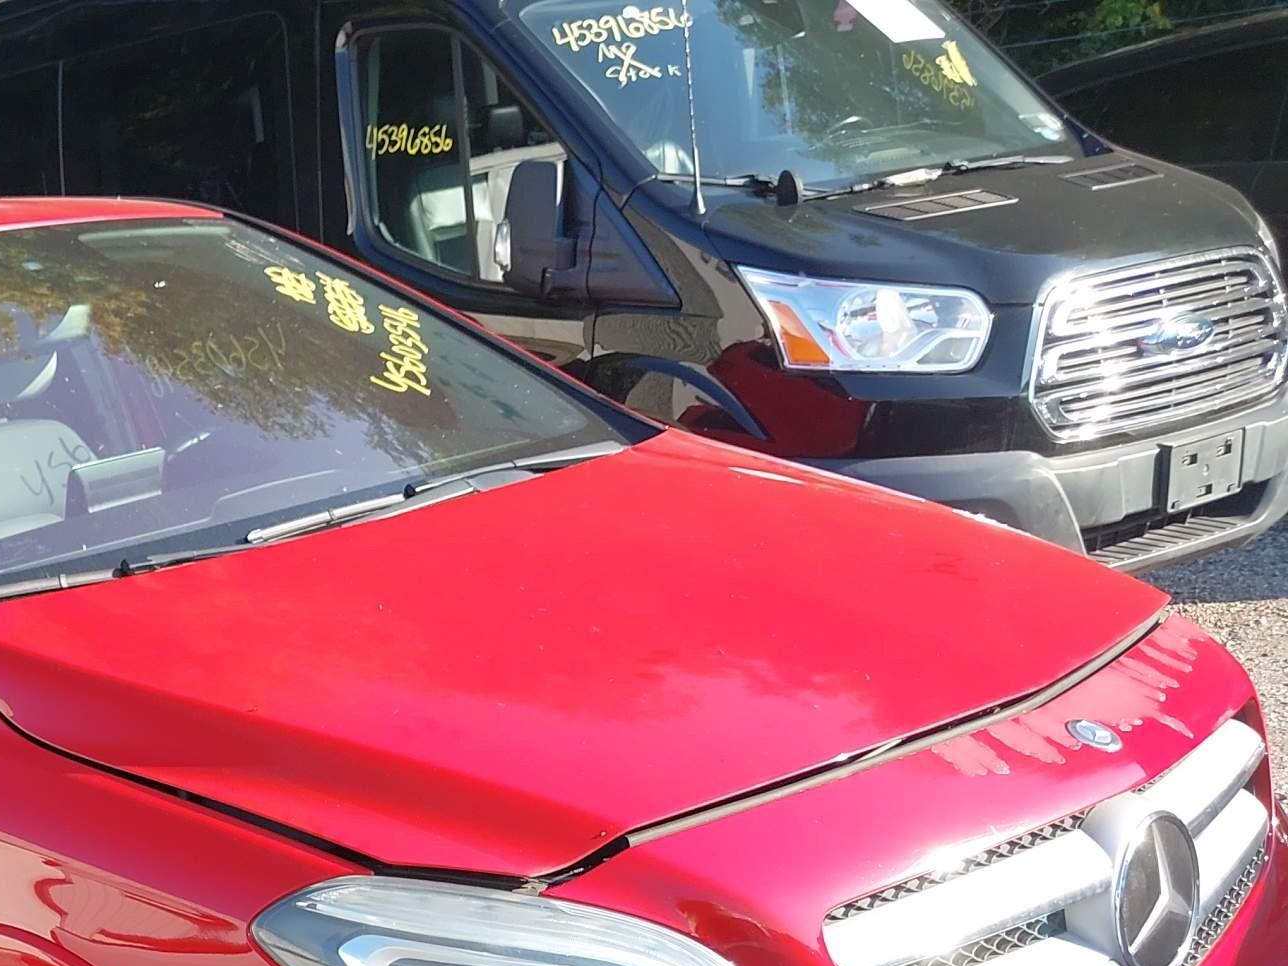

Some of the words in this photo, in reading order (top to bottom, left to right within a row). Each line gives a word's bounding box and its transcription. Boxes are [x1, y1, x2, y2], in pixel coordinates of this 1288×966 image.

[551, 6, 694, 52] 45396856
[365, 123, 453, 161] 45396856
[369, 304, 431, 396] 45603546
